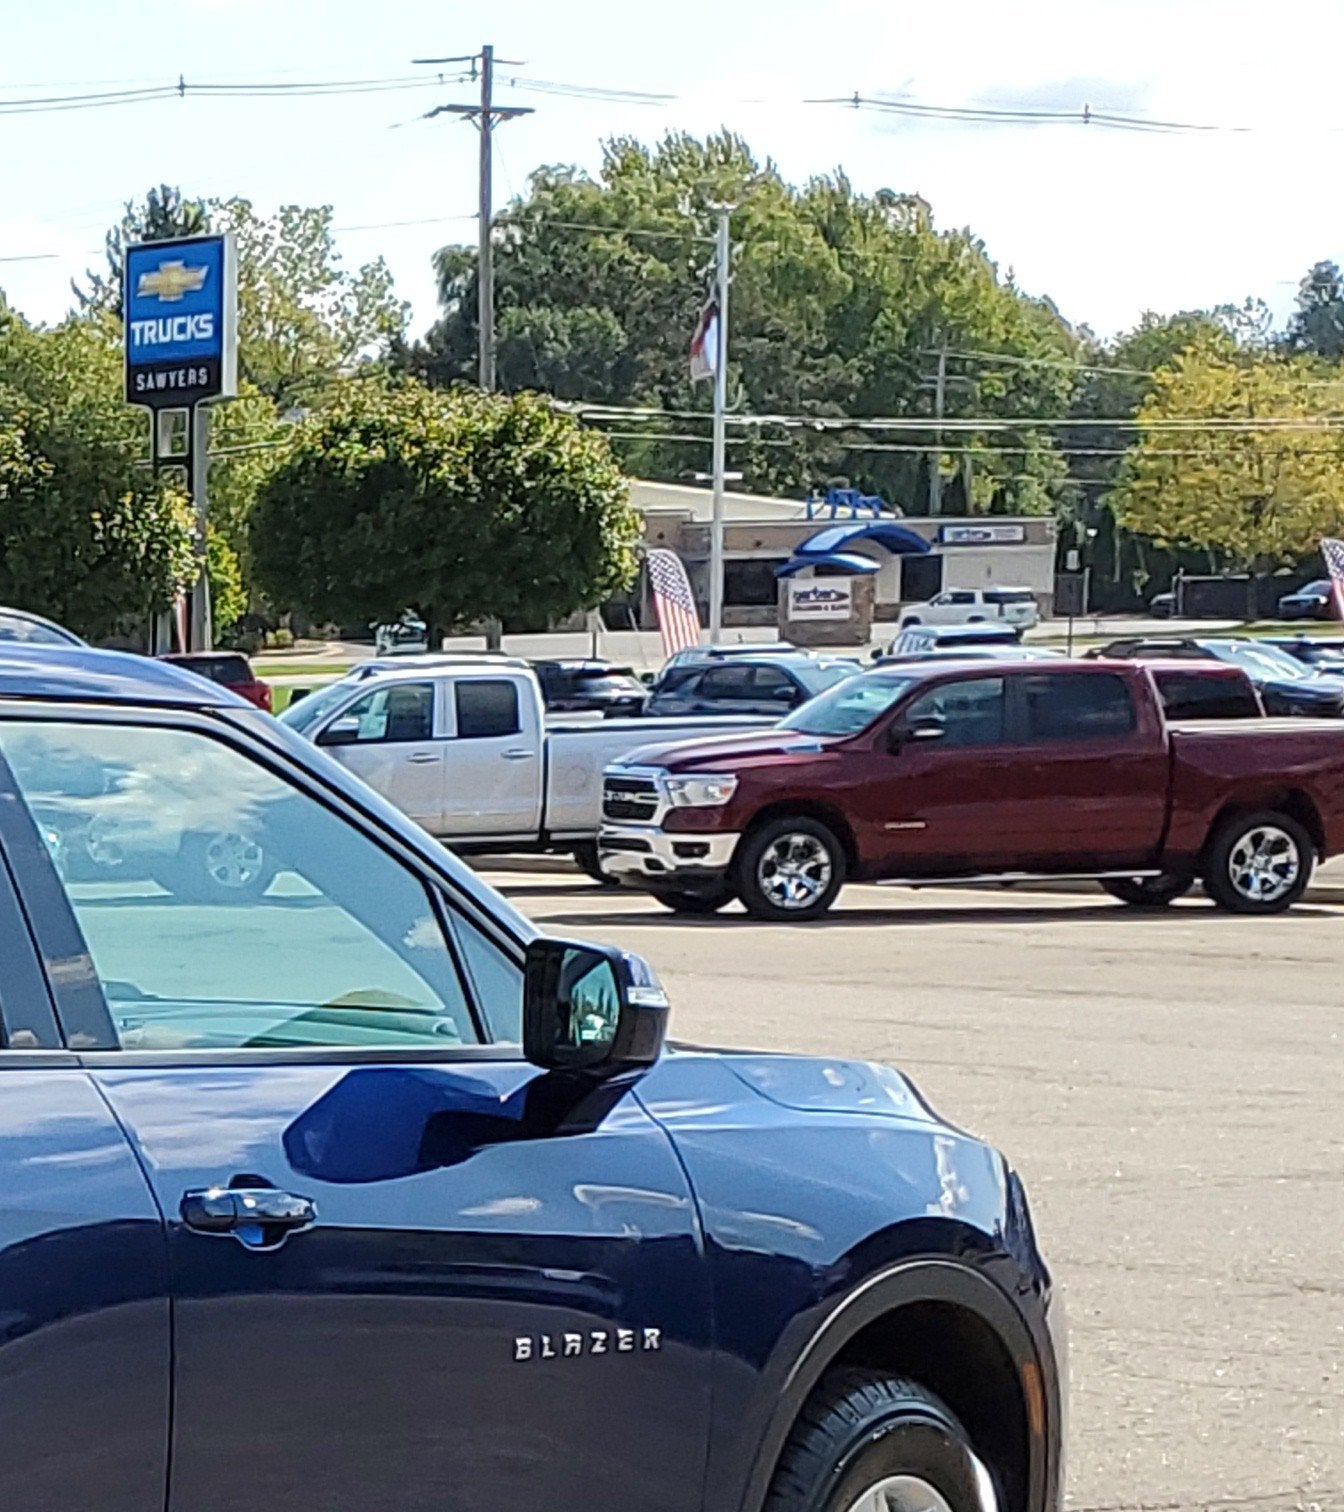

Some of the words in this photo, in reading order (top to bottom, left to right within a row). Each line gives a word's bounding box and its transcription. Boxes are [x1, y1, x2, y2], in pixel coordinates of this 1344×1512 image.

[131, 313, 214, 346] TRUCKS
[136, 367, 208, 391] SAWYERS
[515, 1328, 661, 1360] BLAZER
